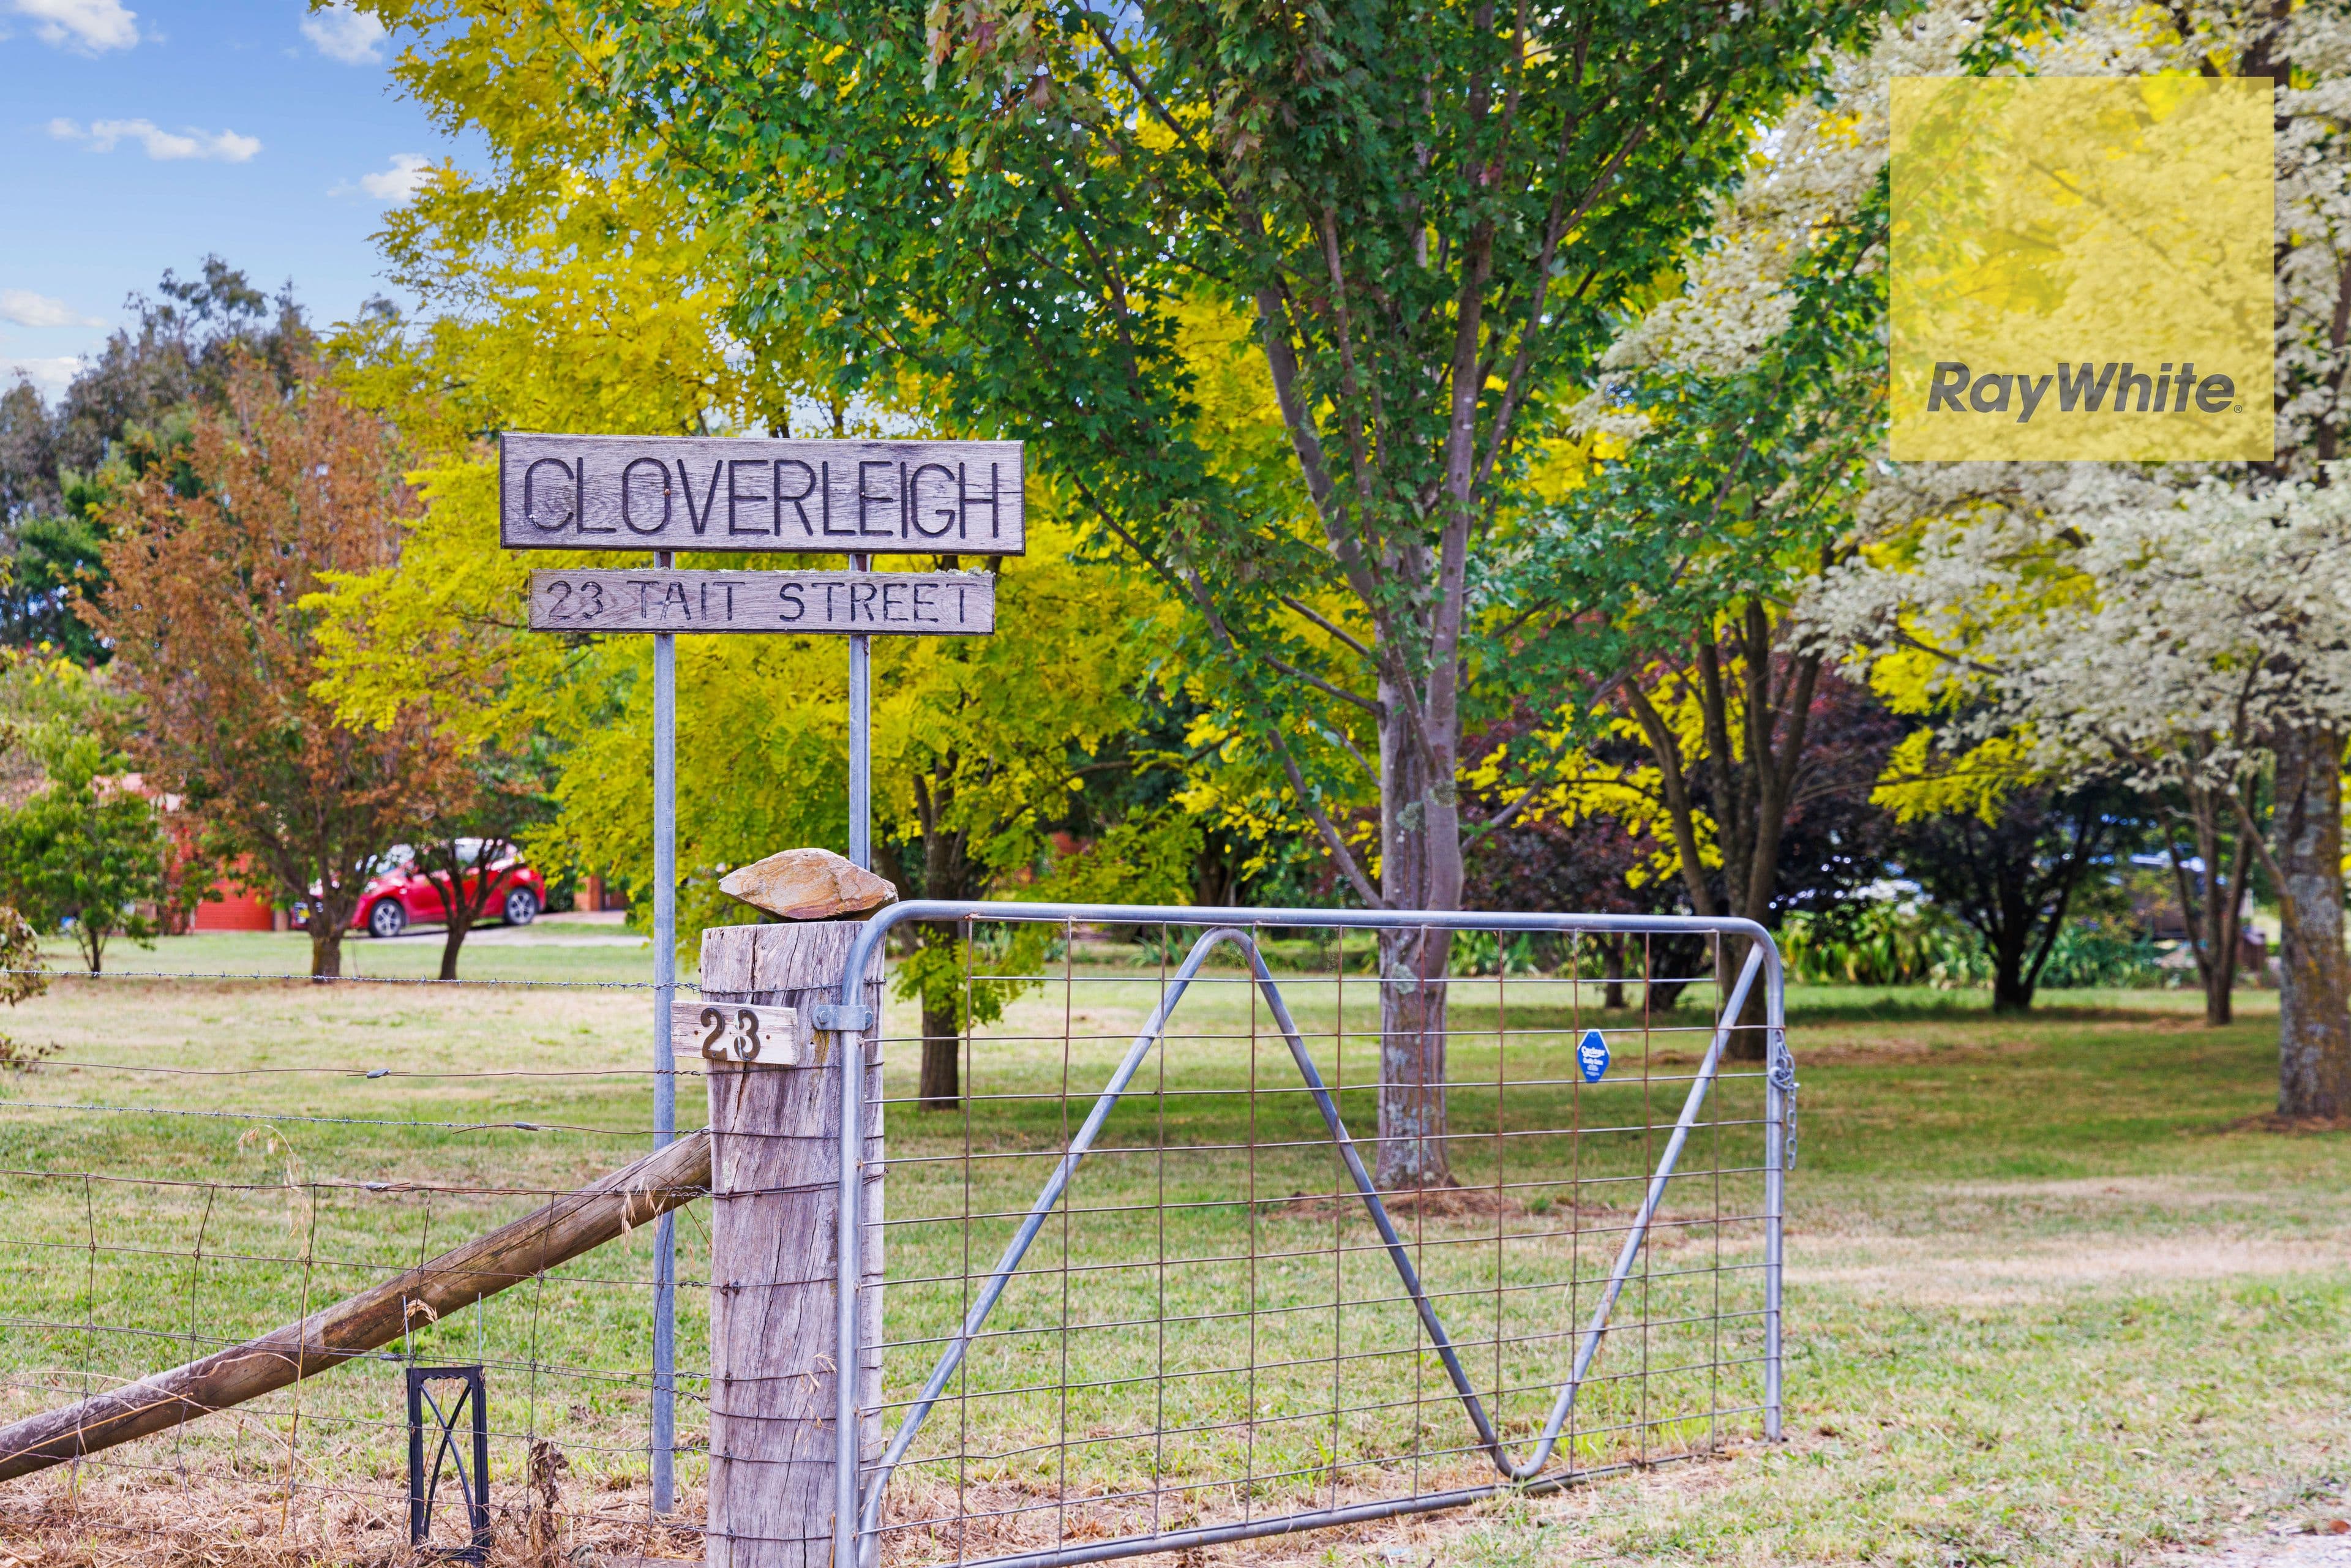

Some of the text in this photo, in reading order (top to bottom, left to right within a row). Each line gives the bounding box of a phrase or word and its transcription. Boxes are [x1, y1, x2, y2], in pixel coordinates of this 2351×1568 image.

[524, 456, 999, 539] CLOVERLEIGH
[547, 580, 978, 623] 23 TAIT STREET
[700, 1007, 761, 1061] 23
